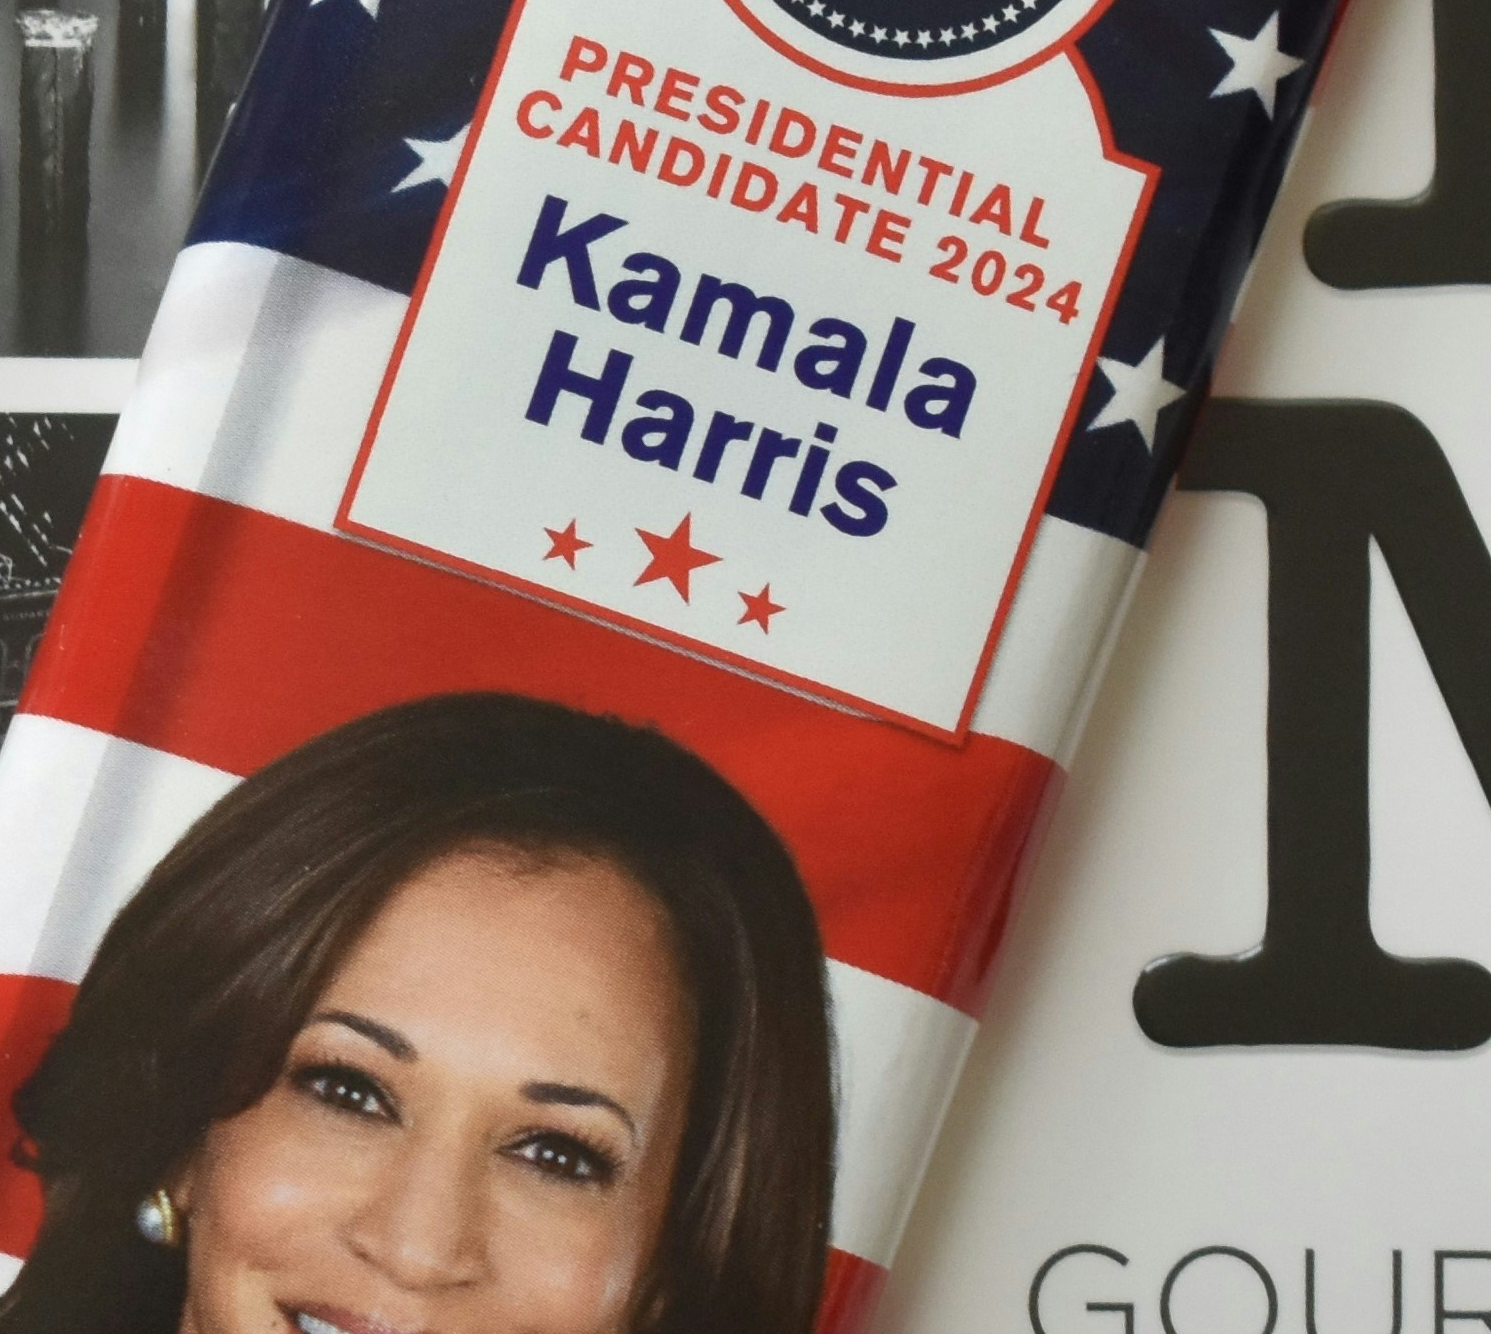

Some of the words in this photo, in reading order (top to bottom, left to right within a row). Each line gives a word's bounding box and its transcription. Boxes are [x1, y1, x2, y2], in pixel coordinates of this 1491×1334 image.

[518, 91, 910, 261] CANDIDATE
[931, 236, 1081, 323] 2024
[561, 37, 1048, 247] PRESIDENTIAL
[516, 195, 977, 438] Kamala
[525, 331, 899, 538] Harris
